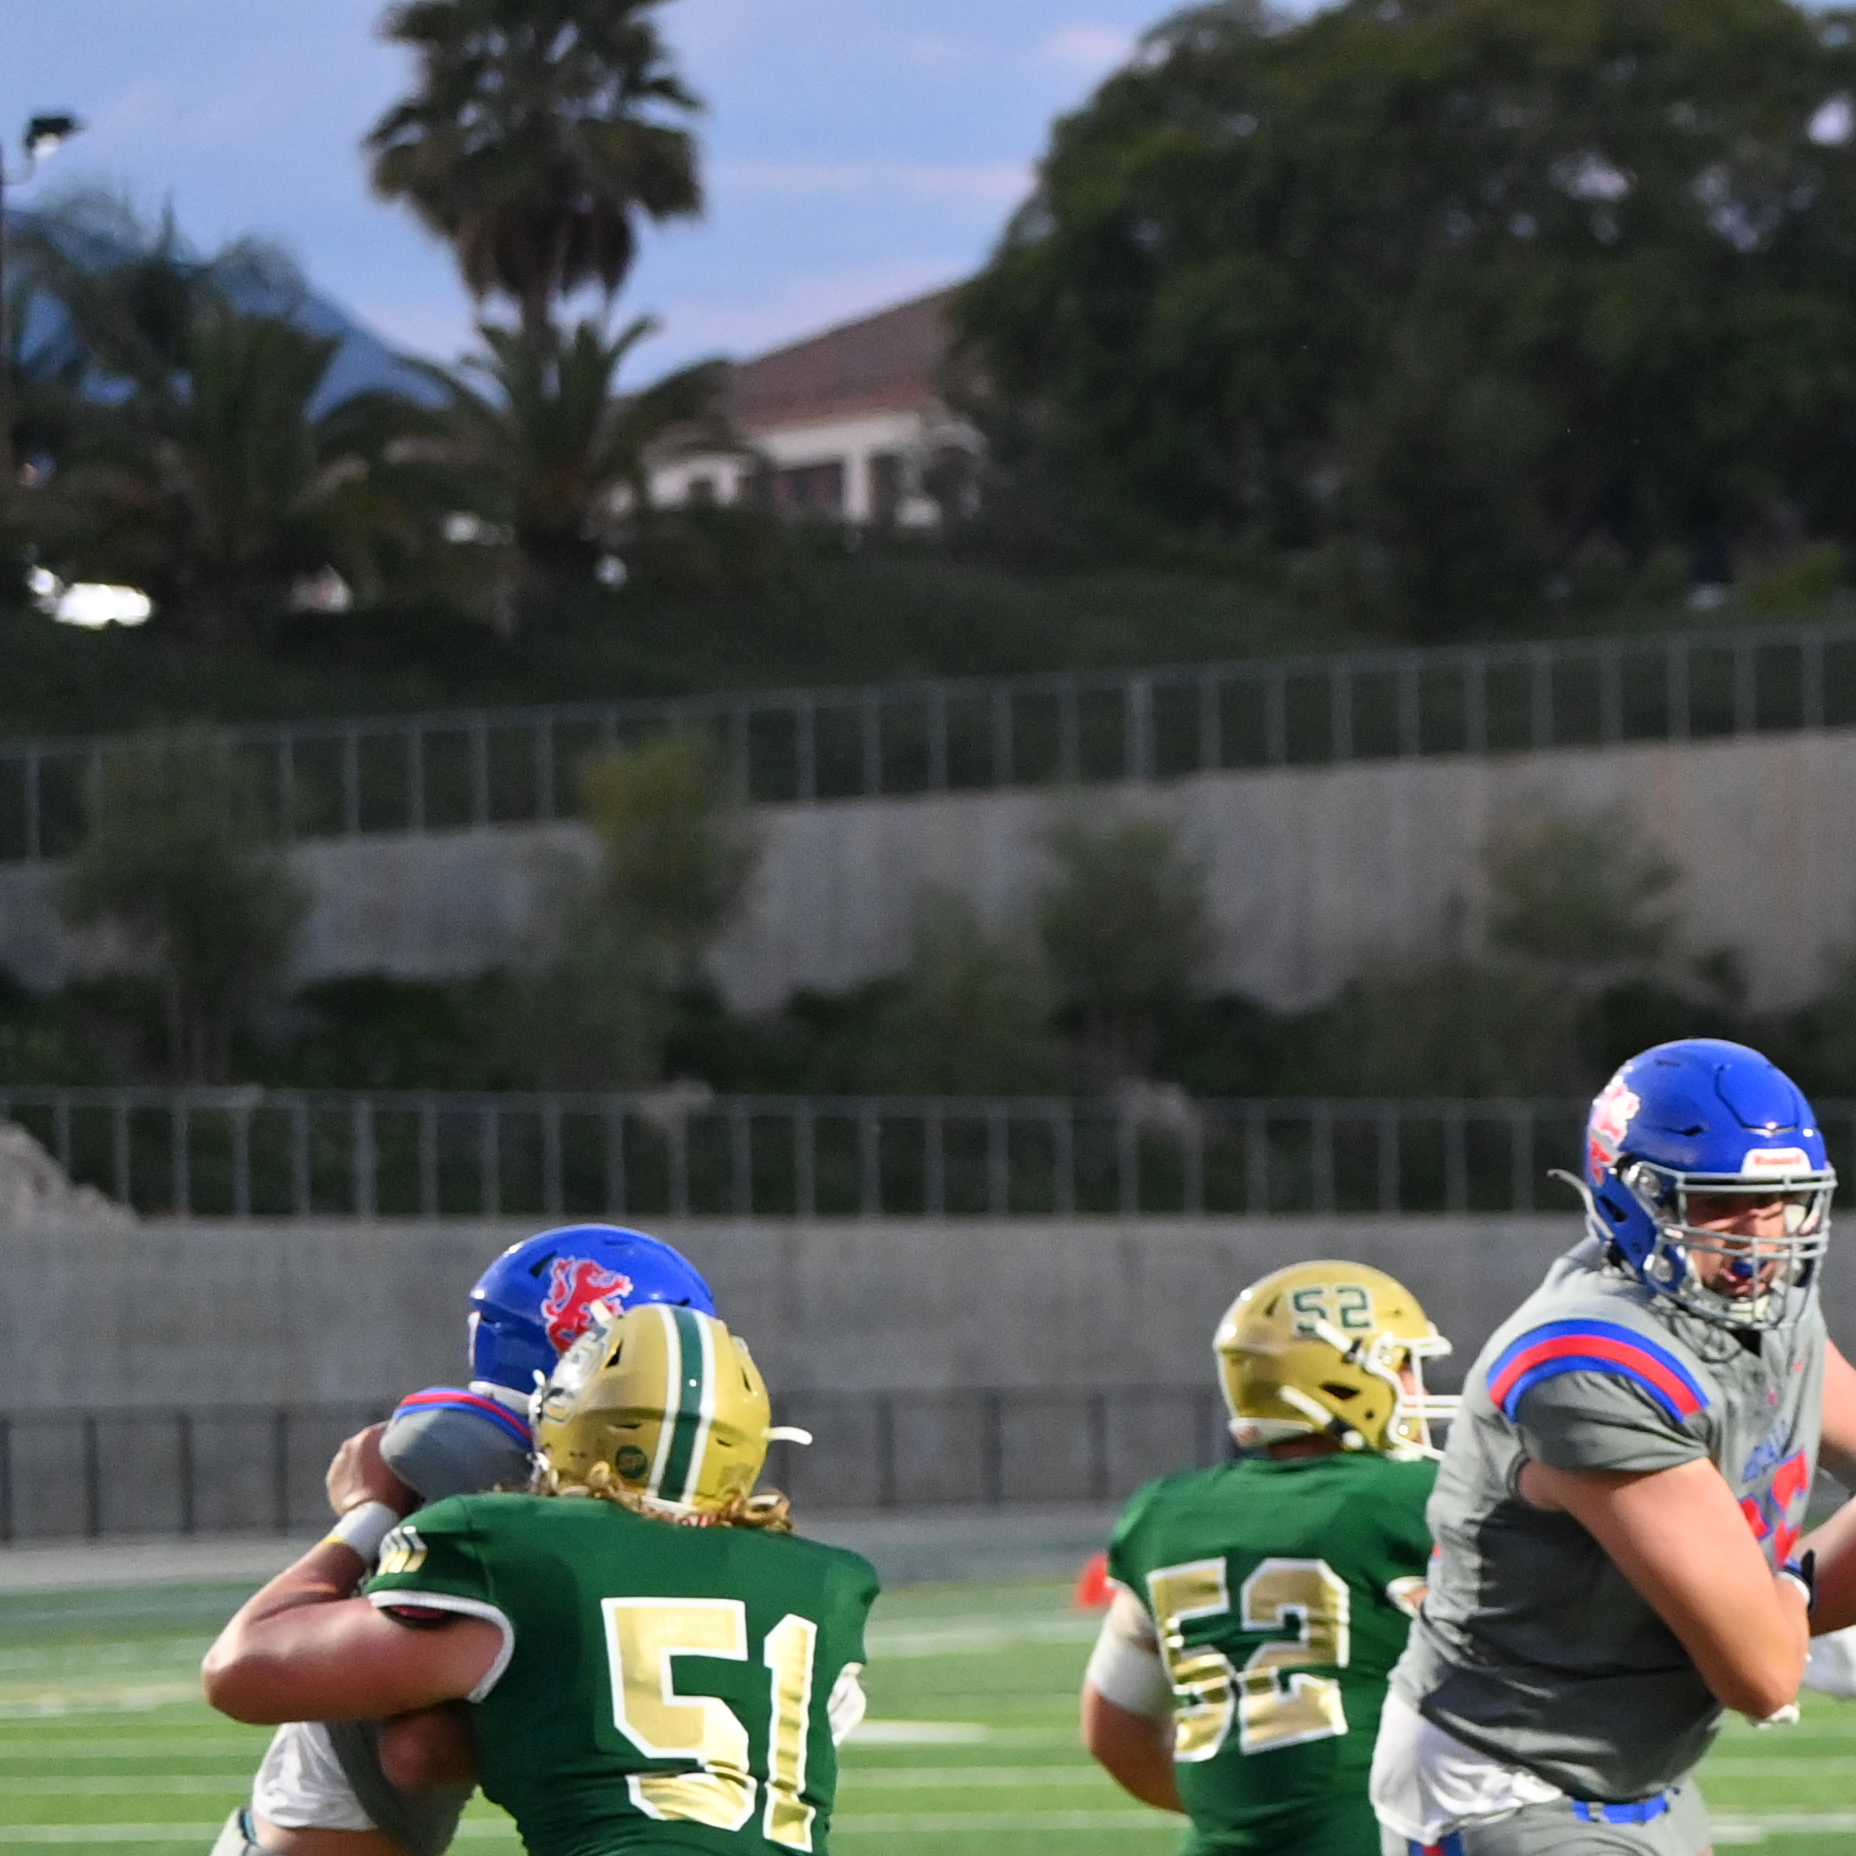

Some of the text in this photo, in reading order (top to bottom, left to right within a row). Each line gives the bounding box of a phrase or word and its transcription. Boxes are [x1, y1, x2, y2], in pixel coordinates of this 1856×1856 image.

[1287, 1282, 1375, 1337] 52
[600, 1596, 819, 1853] 51
[1147, 1557, 1352, 1763] 52
